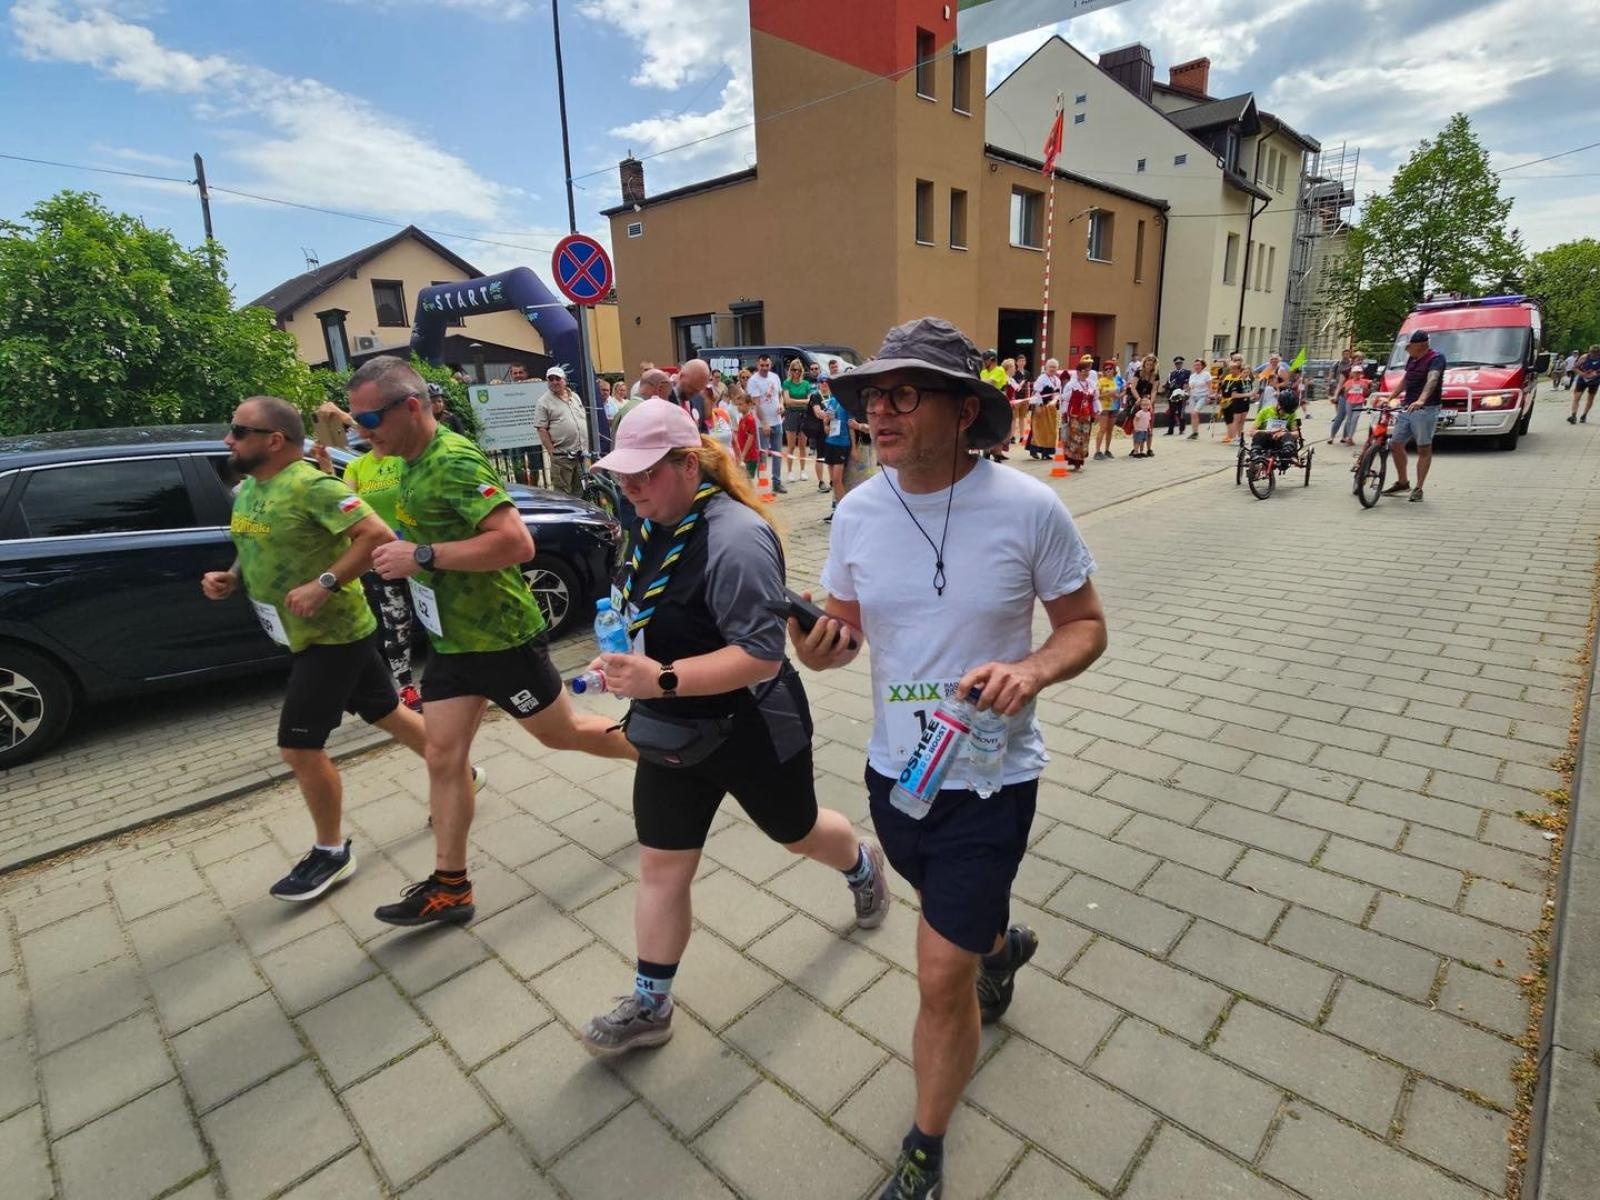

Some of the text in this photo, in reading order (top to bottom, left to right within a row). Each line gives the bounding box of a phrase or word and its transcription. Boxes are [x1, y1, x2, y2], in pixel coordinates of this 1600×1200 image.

[434, 286, 490, 311] START
[888, 682, 942, 702] XXIX
[899, 719, 941, 784] OSHEE
